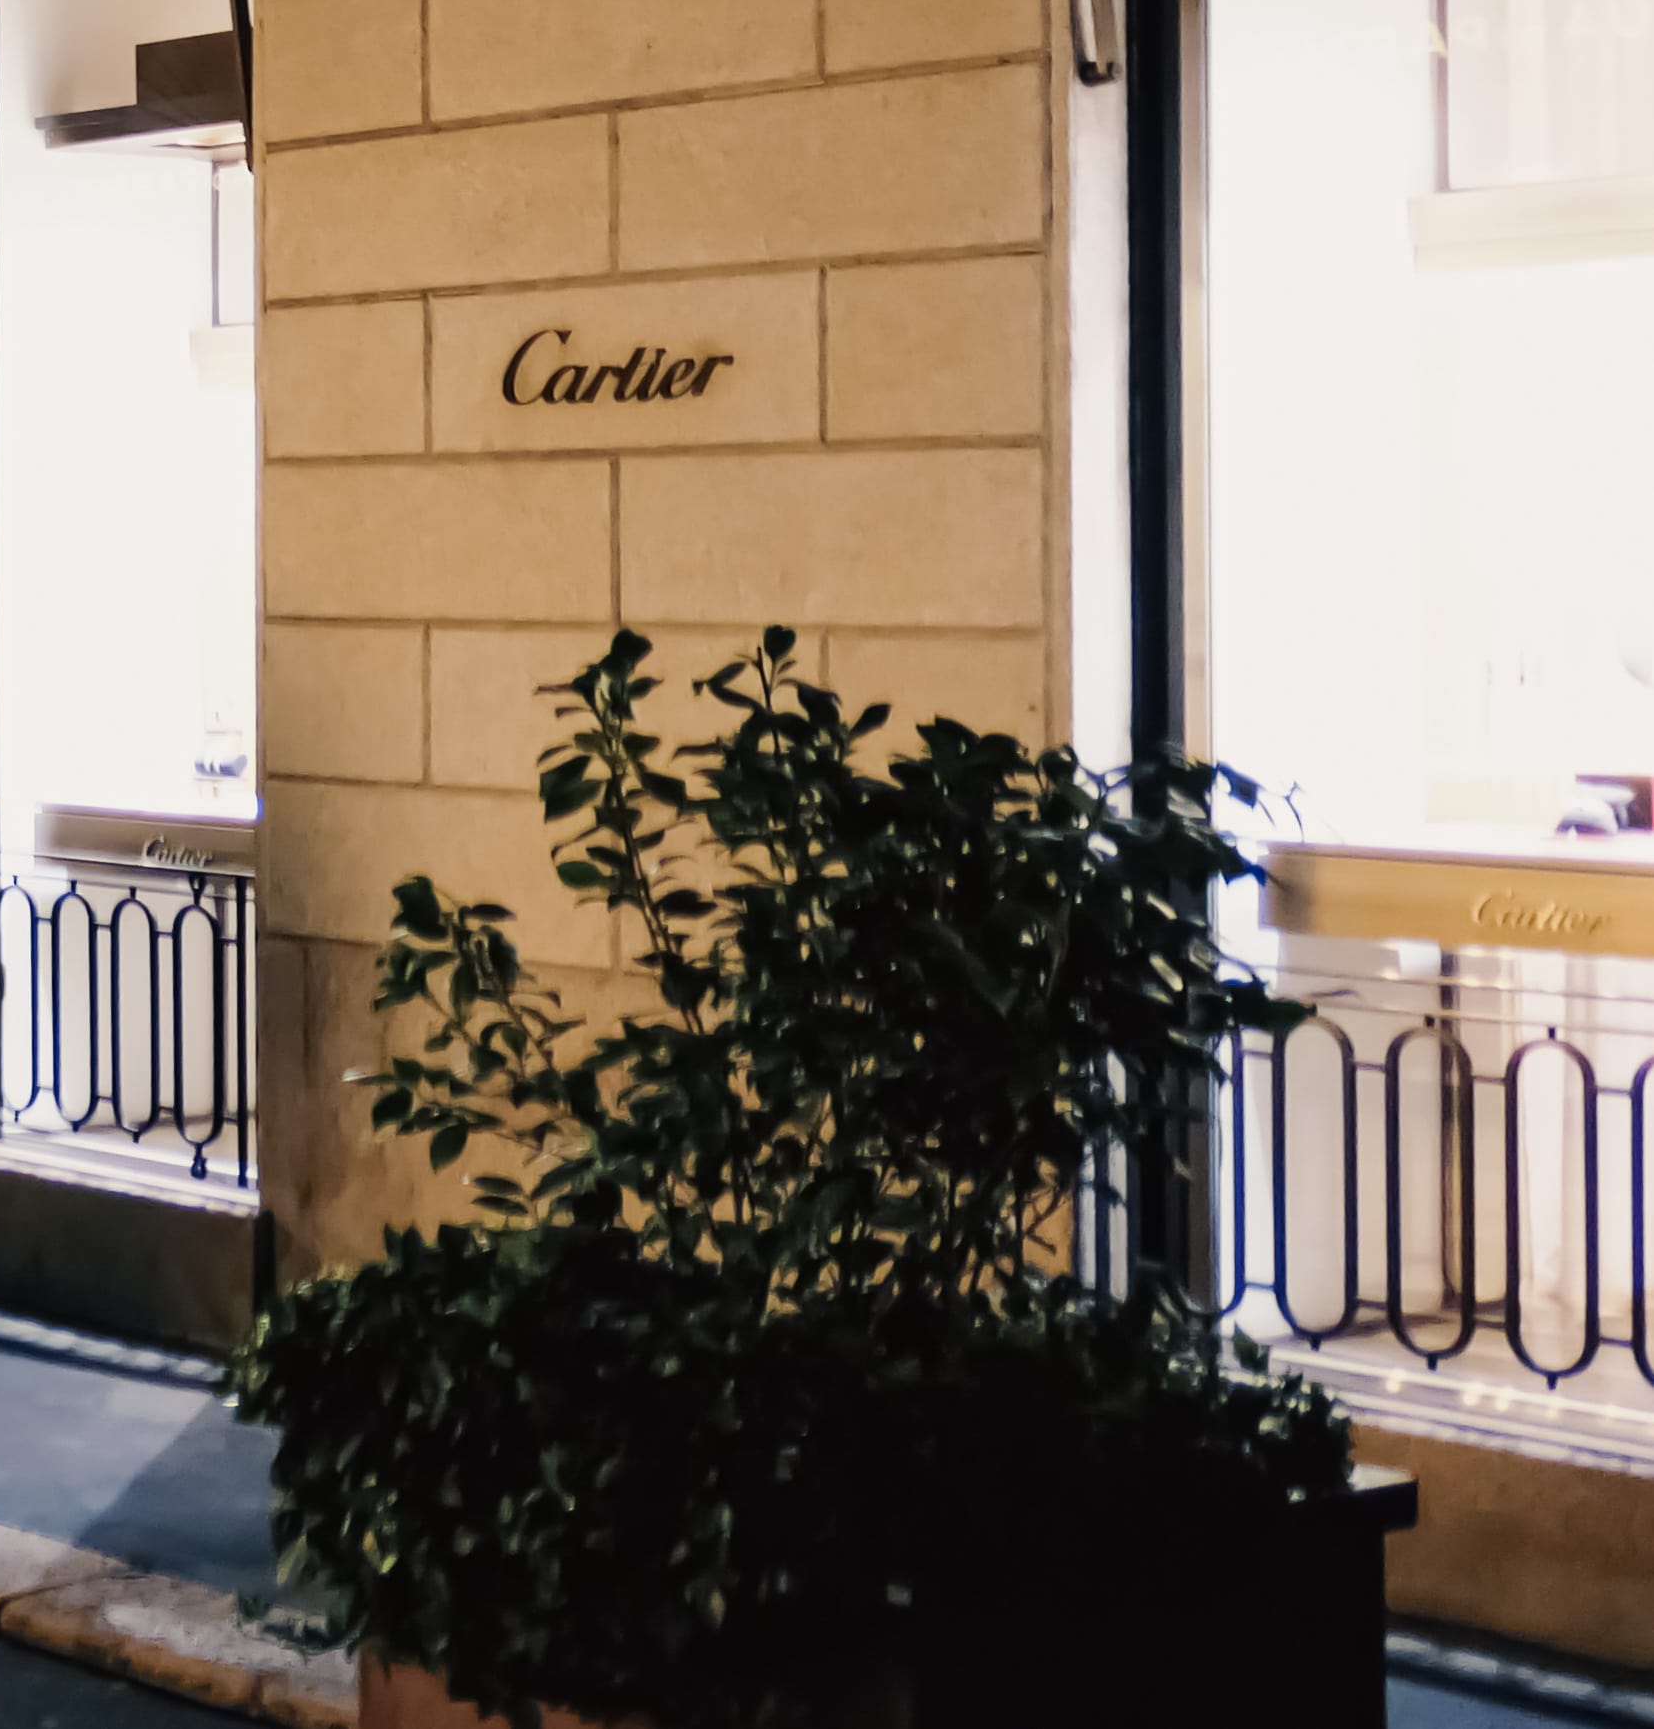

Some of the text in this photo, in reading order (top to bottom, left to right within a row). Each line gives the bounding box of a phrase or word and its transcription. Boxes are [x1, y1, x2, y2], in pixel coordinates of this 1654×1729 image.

[501, 328, 735, 406] Cartier
[144, 833, 214, 869] Cartier
[1471, 886, 1613, 935] Cartier
